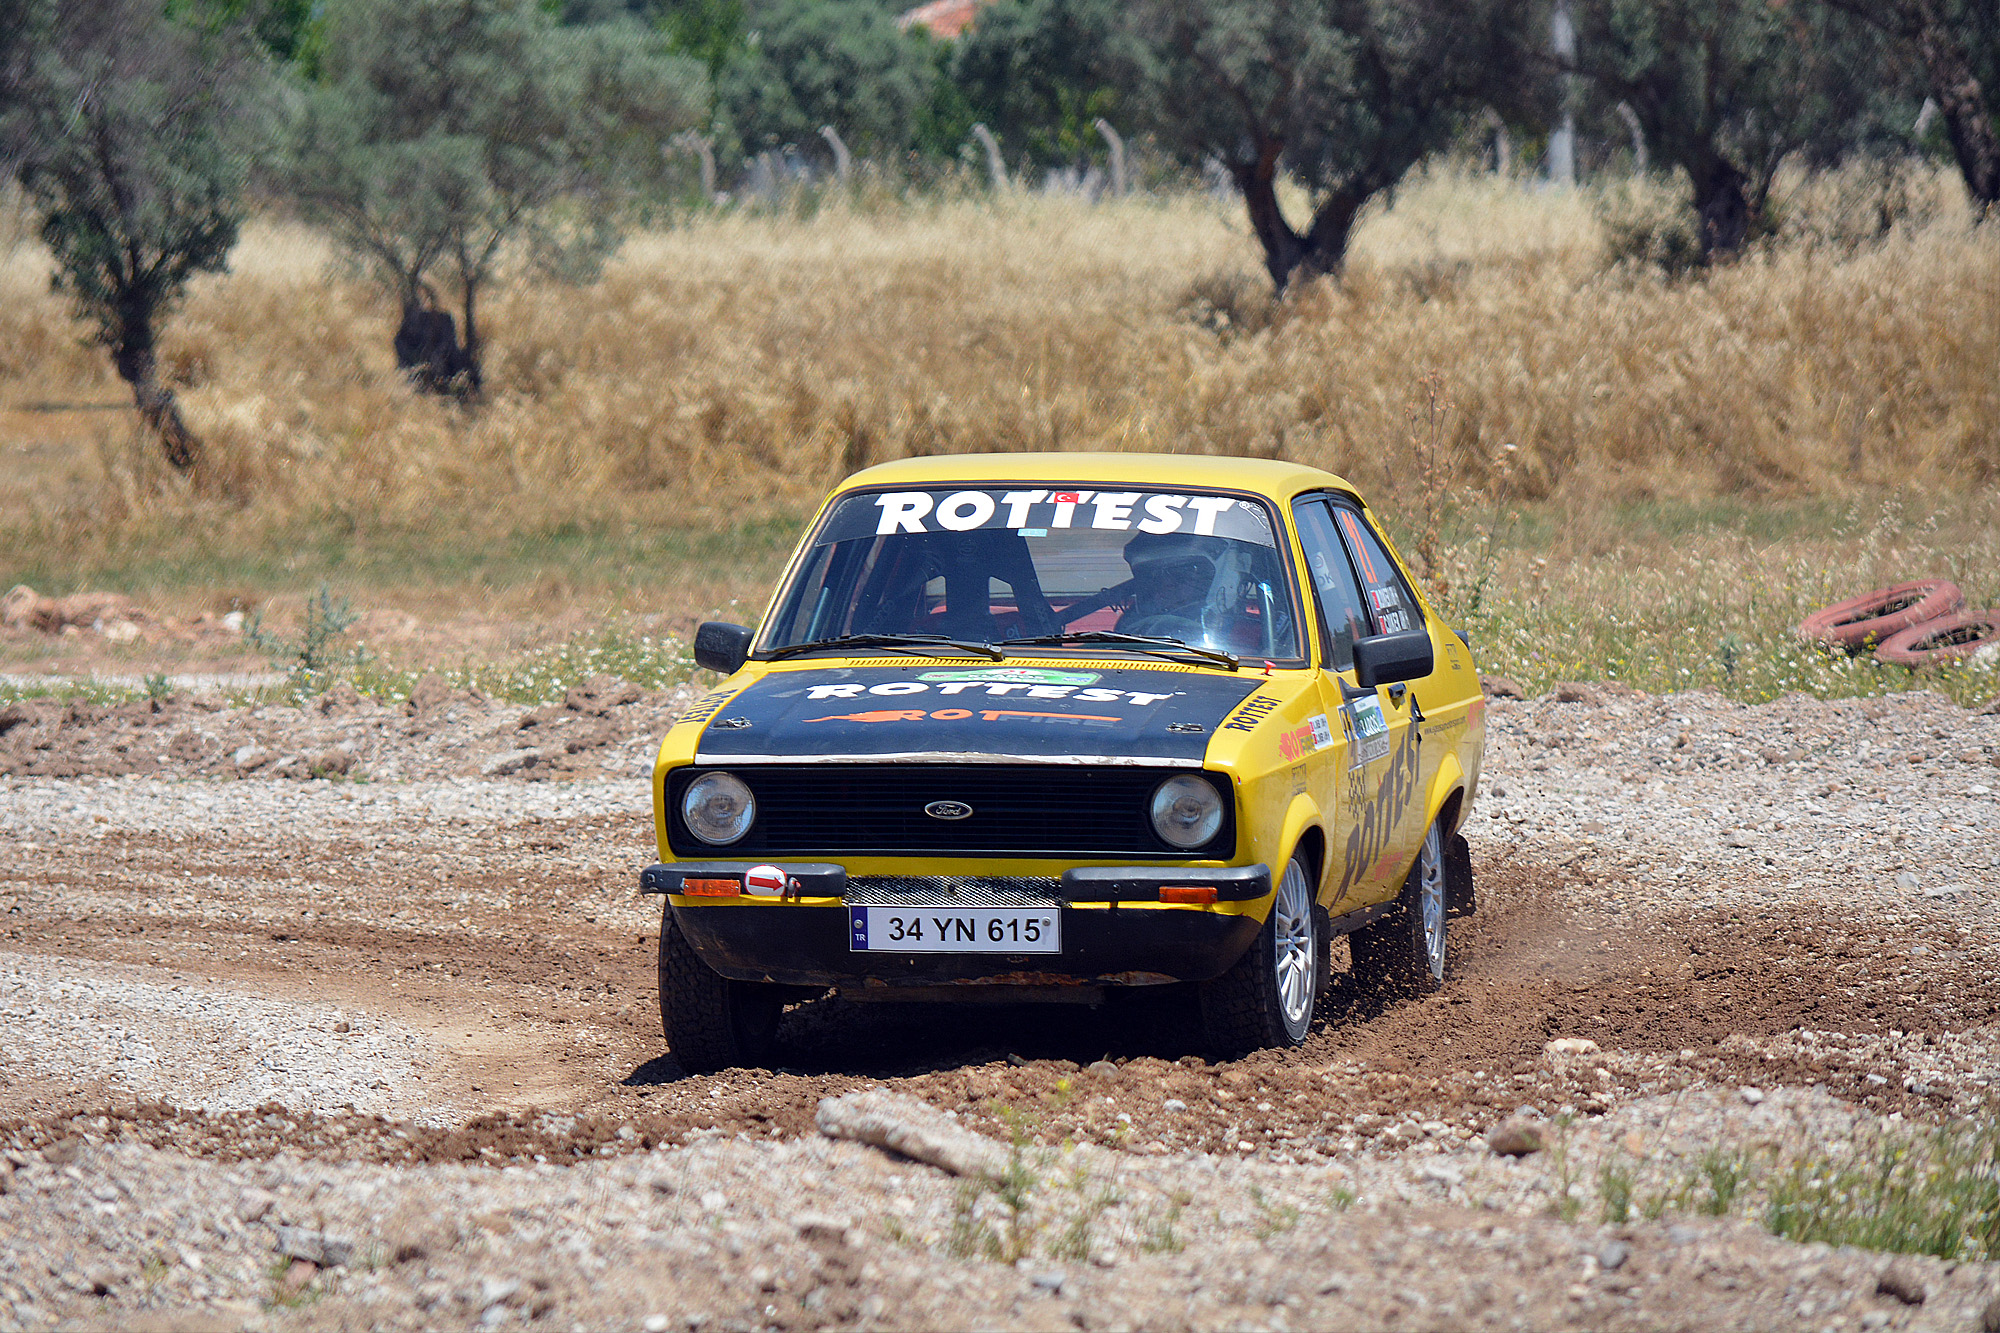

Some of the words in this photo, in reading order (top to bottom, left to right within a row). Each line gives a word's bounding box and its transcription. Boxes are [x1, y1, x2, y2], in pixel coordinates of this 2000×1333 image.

[874, 490, 1238, 535] ROTTEST
[806, 682, 1172, 706] ROTTEST
[1224, 695, 1282, 733] ROTTEST
[936, 804, 962, 816] Ford
[1328, 717, 1419, 912] ROTTEST
[855, 933, 866, 942] TR
[888, 917, 923, 941] 34
[932, 917, 975, 942] YN
[988, 918, 1040, 942] 615
